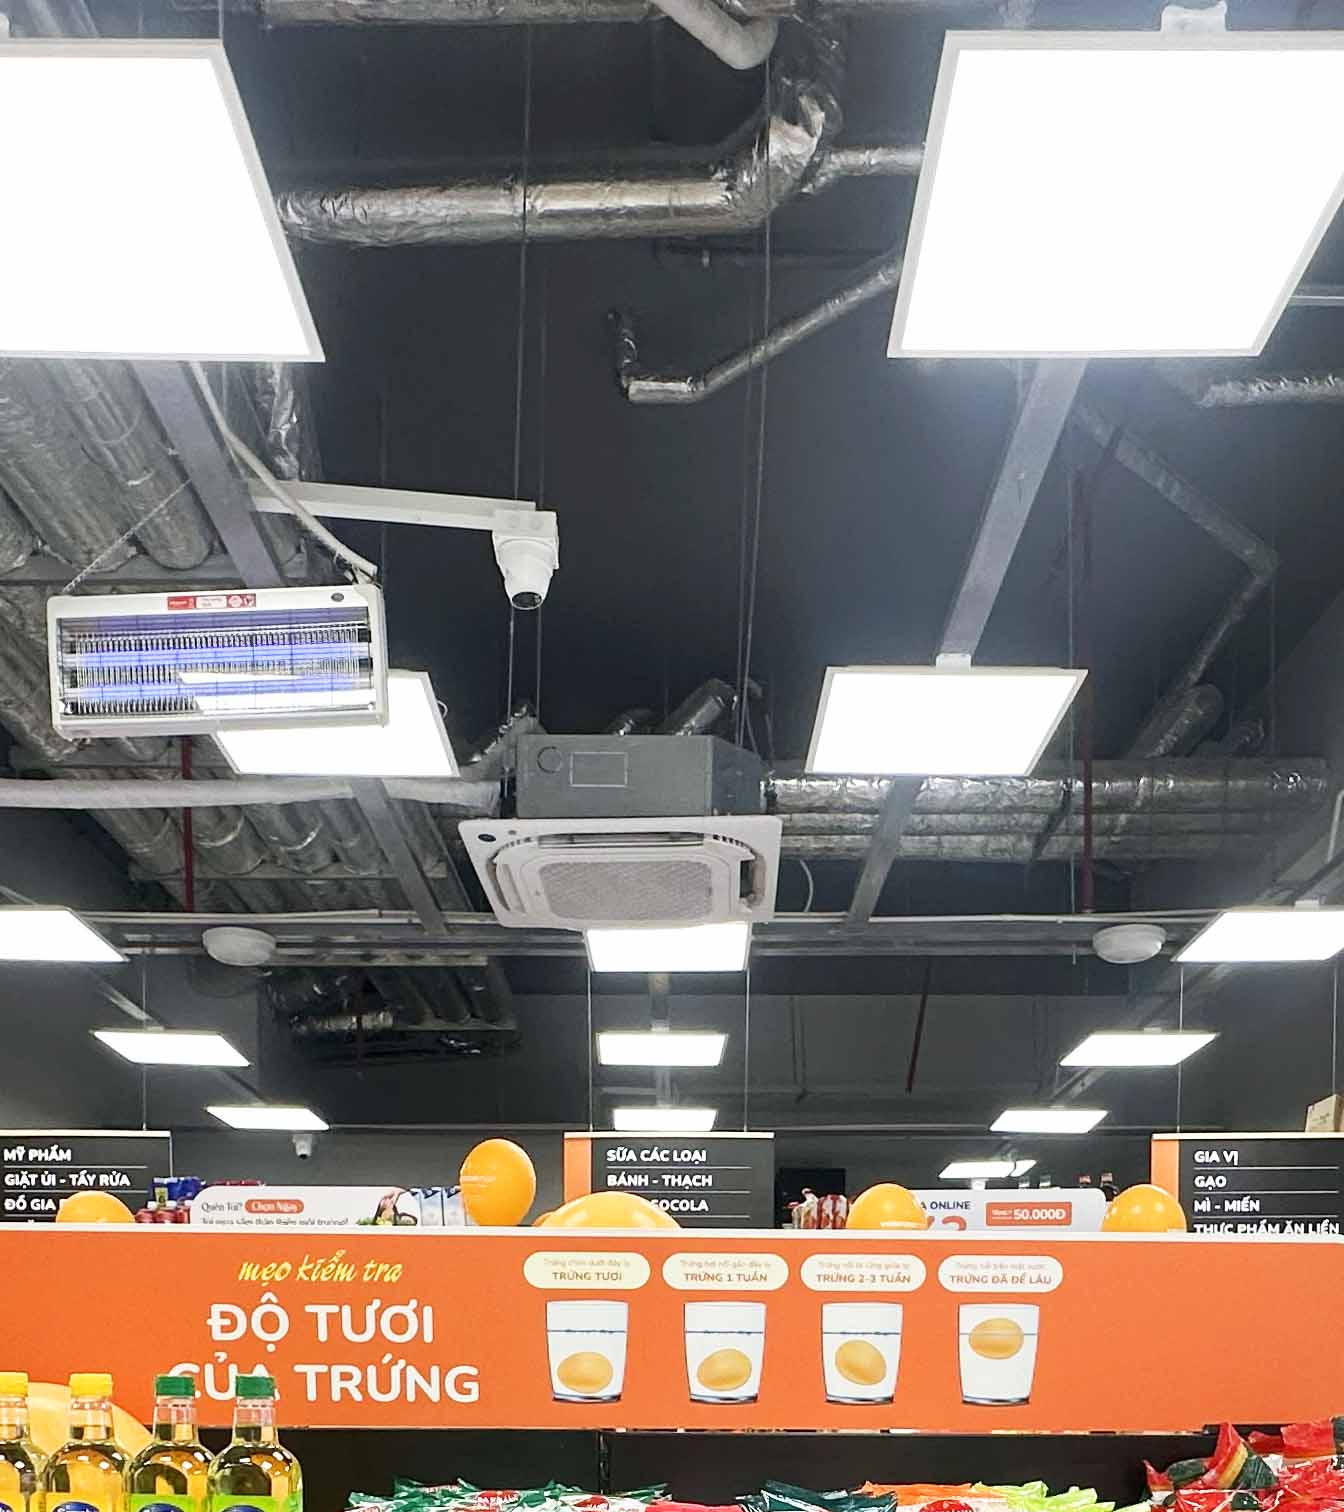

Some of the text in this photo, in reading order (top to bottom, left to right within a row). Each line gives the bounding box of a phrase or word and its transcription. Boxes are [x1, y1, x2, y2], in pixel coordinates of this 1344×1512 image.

[4, 1143, 71, 1161] MỸ PHẨM
[607, 1146, 707, 1165] SỮA CÁC LOẠI
[1194, 1150, 1239, 1166] GIA VỊ
[104, 1170, 130, 1186] RỬA
[607, 1172, 712, 1190] BÁNH THẠCH
[1194, 1175, 1227, 1190] GẠO
[930, 1201, 971, 1210] ONLINE
[1194, 1197, 1260, 1212] MÌ MIẾN
[1014, 1209, 1066, 1219] 50.000Đ
[239, 1249, 402, 1285] mẹo kiểm tra
[208, 1293, 433, 1352] ĐỘ TƯƠI
[294, 1353, 480, 1403] TRỨNG
